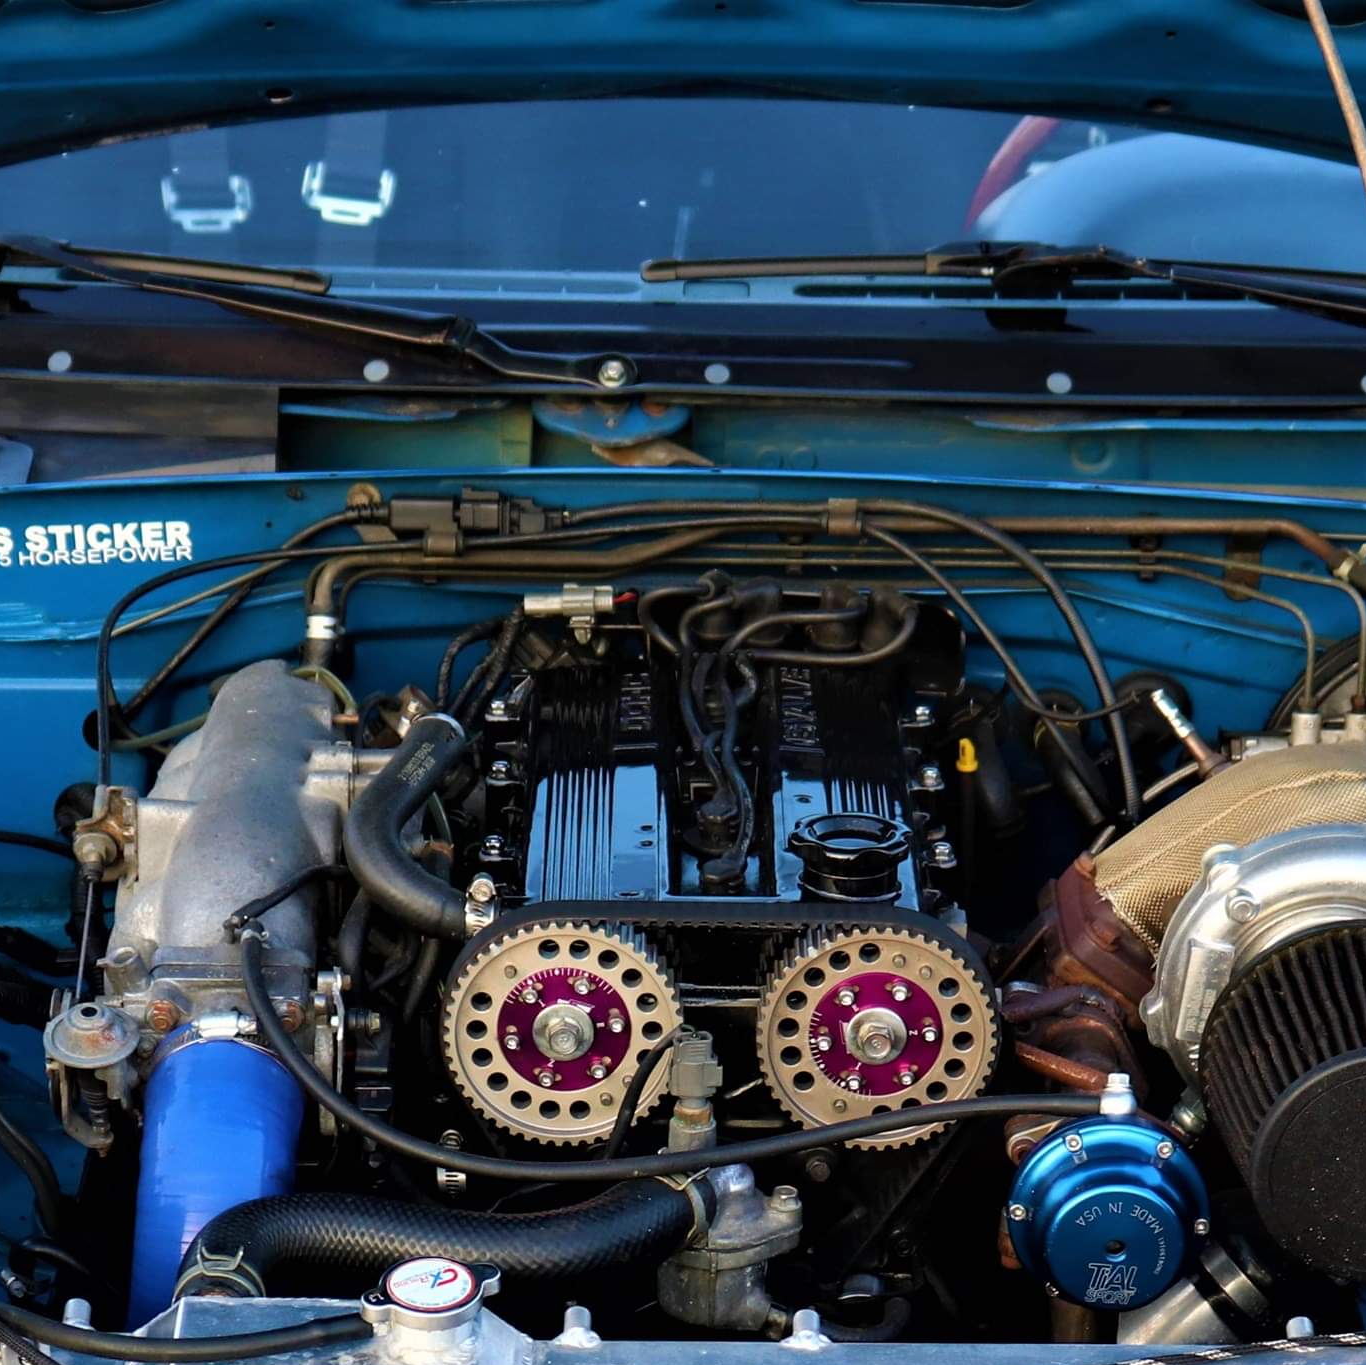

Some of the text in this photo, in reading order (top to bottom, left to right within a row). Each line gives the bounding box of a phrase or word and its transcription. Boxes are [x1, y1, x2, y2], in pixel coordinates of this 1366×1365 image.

[24, 521, 192, 552] STICKER
[18, 545, 193, 567] HORSEPOWER
[1075, 1202, 1163, 1234] MADE IN USA
[1084, 1288, 1136, 1305] SPORT
